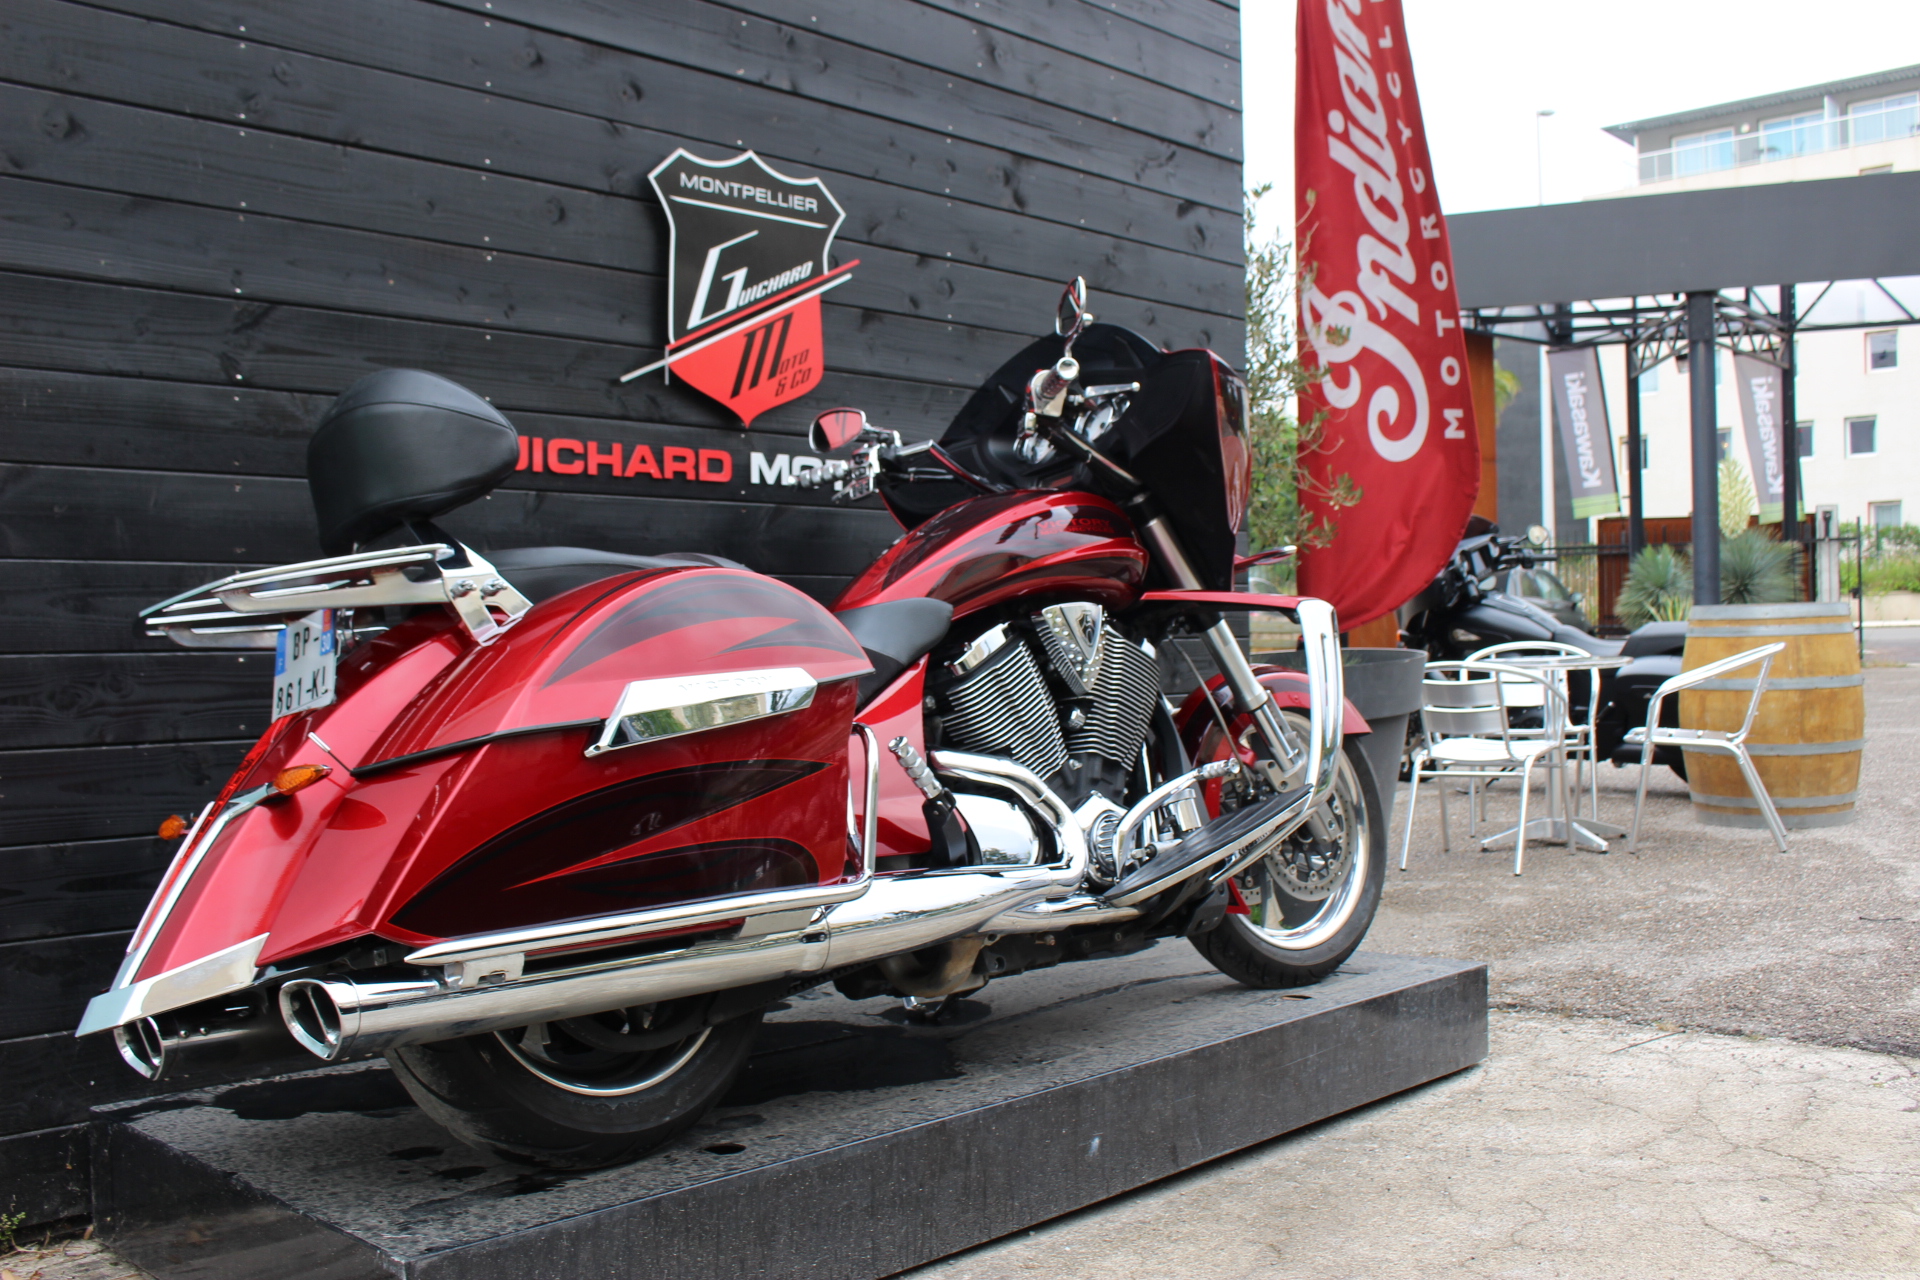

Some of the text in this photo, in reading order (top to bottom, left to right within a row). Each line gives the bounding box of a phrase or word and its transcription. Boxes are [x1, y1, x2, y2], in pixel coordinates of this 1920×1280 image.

[680, 171, 818, 213] MONTPELLIER
[1370, 0, 1466, 440] MOTORCYCL
[514, 435, 734, 484] ICHARD
[1036, 518, 1111, 530] VICTORY
